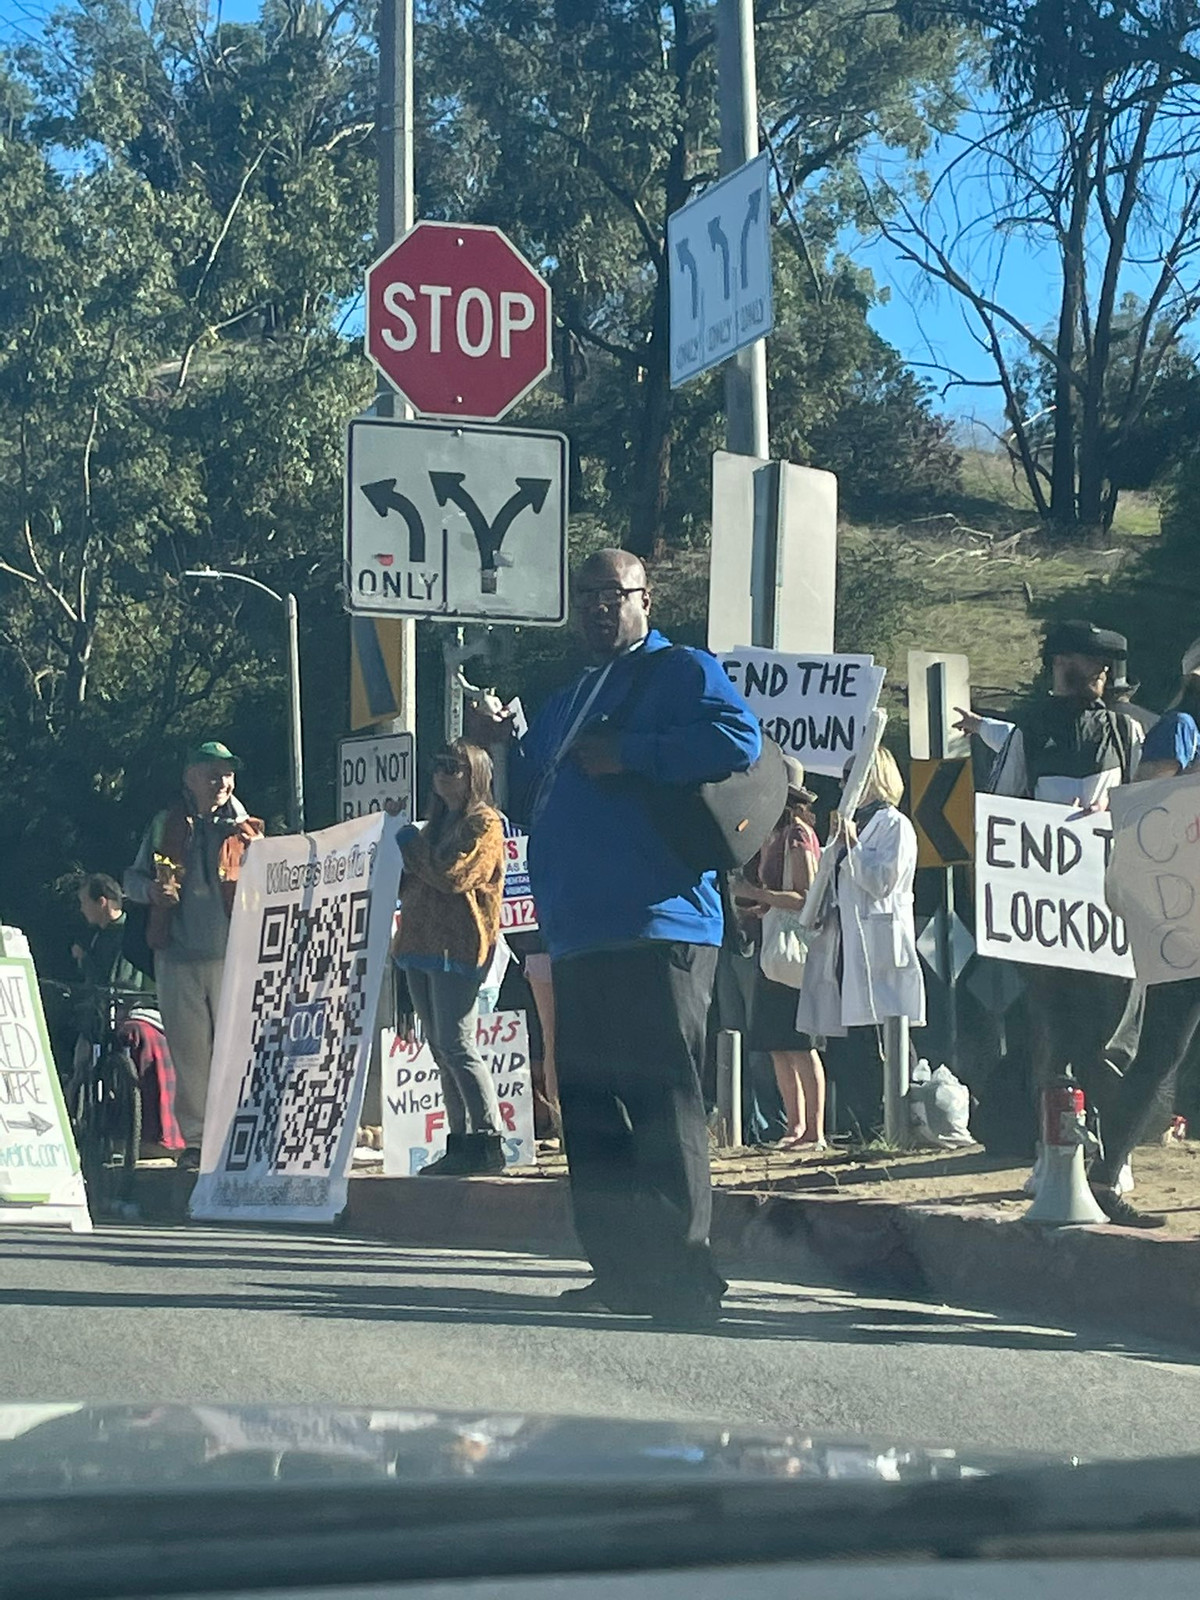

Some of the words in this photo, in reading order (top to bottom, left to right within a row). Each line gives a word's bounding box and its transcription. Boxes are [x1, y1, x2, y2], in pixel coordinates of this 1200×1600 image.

[381, 281, 535, 359] STOP
[358, 568, 440, 600] ONLY
[797, 661, 861, 697] THE
[343, 757, 367, 788] DO
[376, 751, 410, 785] NOT
[986, 815, 1083, 876] END
[500, 900, 536, 927] 012
[984, 882, 1129, 957] LOCKDO
[479, 1052, 526, 1075] ND
[387, 1089, 444, 1115] Wher
[497, 1082, 525, 1098] UR
